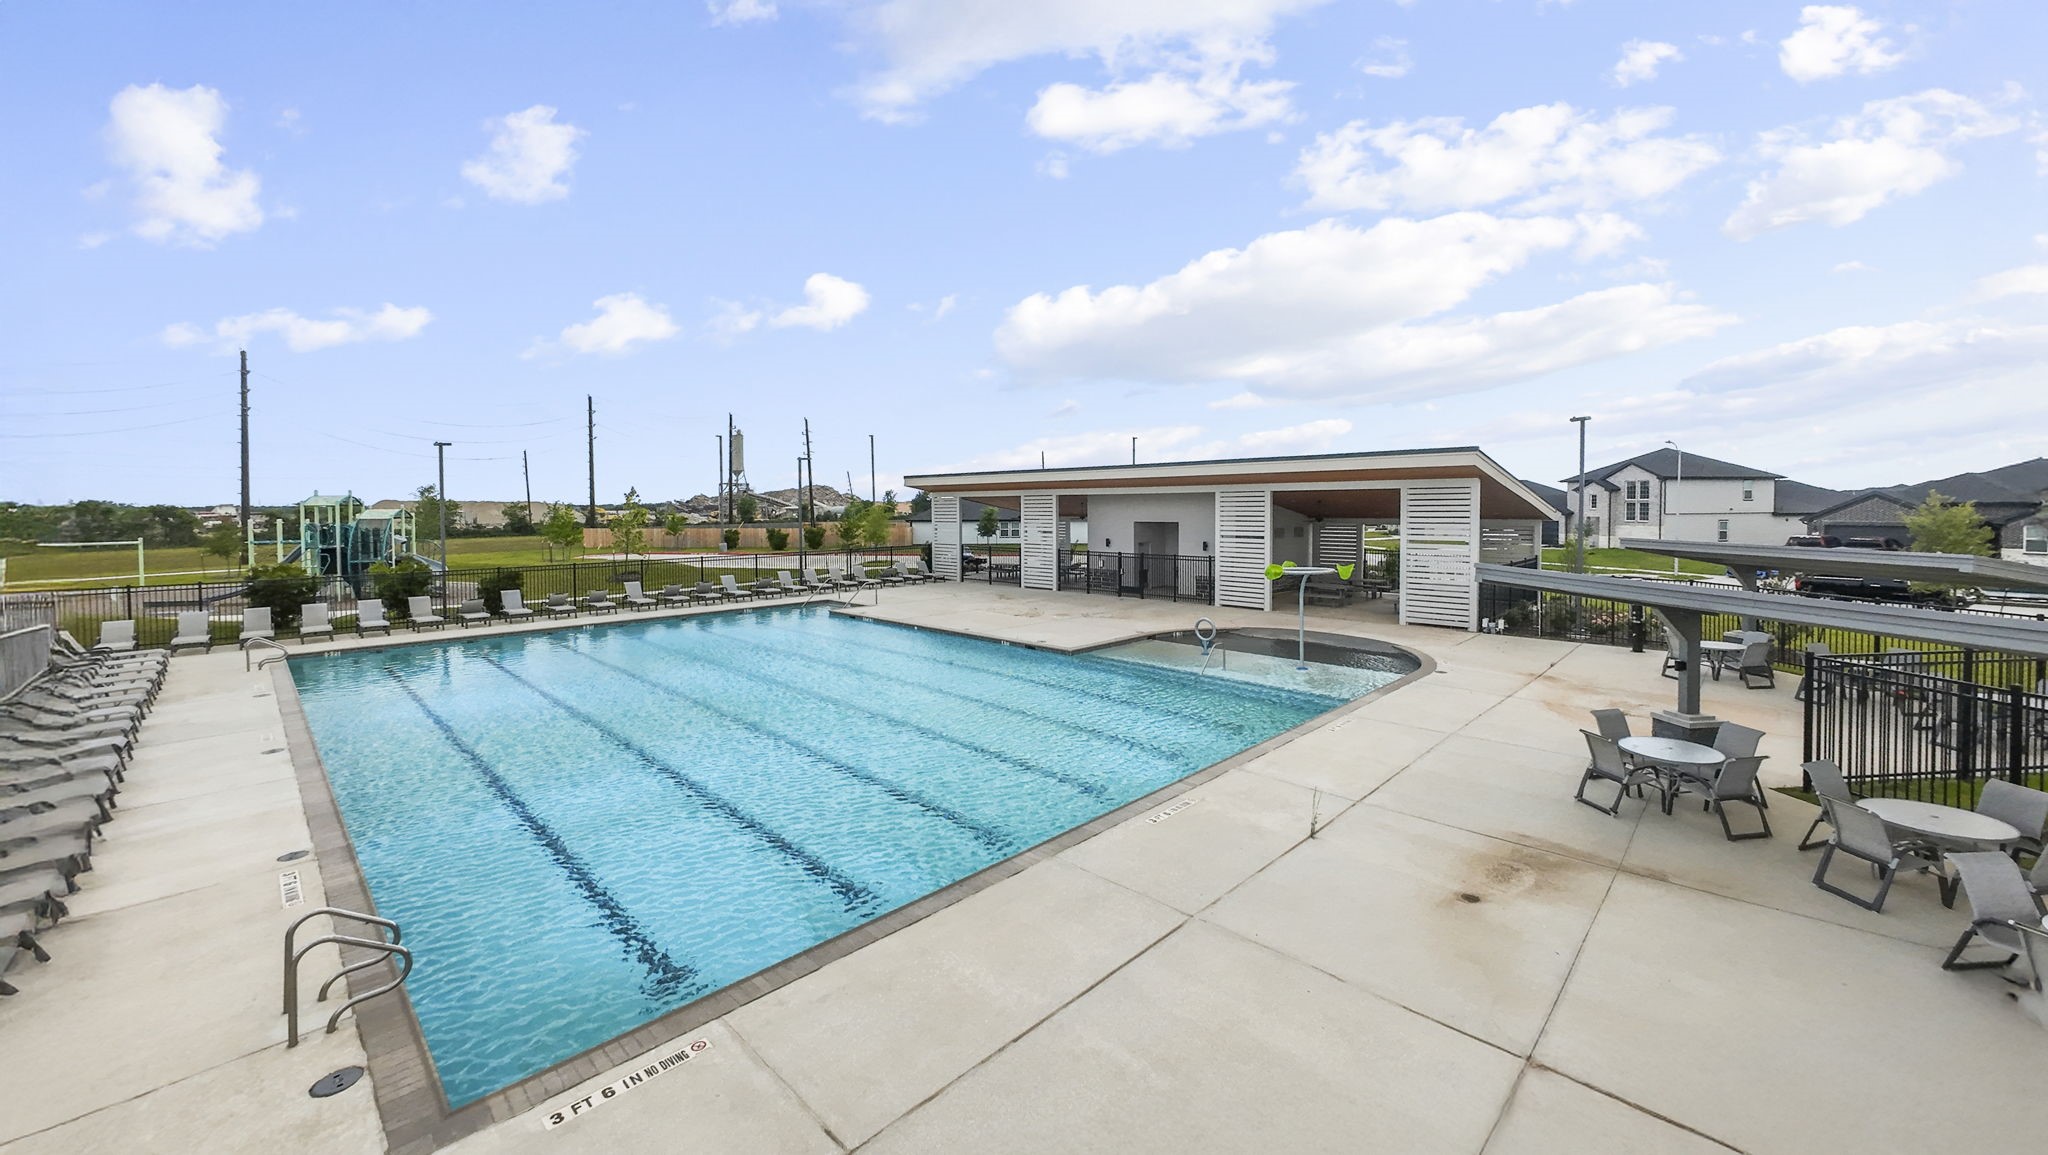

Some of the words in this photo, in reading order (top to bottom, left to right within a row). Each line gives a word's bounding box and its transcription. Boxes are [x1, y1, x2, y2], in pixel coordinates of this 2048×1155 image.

[549, 1112, 565, 1125] 3
[570, 1096, 592, 1115] FT
[601, 1086, 617, 1099] 6
[622, 1073, 643, 1089] IN
[644, 1065, 660, 1078] NO
[658, 1050, 690, 1070] DIVING
